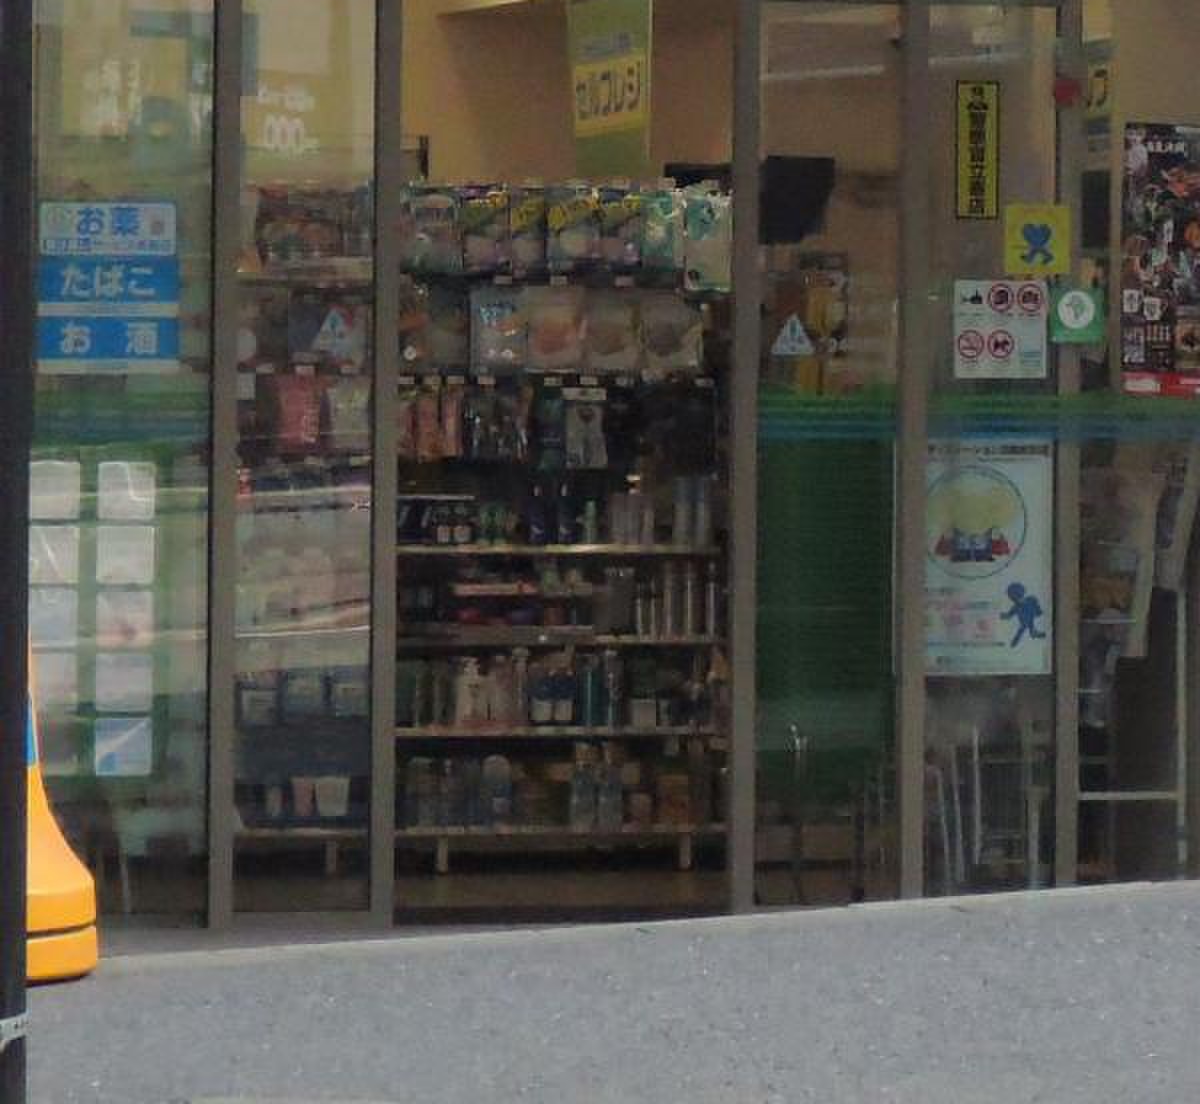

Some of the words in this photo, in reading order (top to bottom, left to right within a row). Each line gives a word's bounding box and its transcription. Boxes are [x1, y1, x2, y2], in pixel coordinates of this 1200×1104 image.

[77, 205, 141, 237] お薬
[60, 264, 157, 298] たばこ
